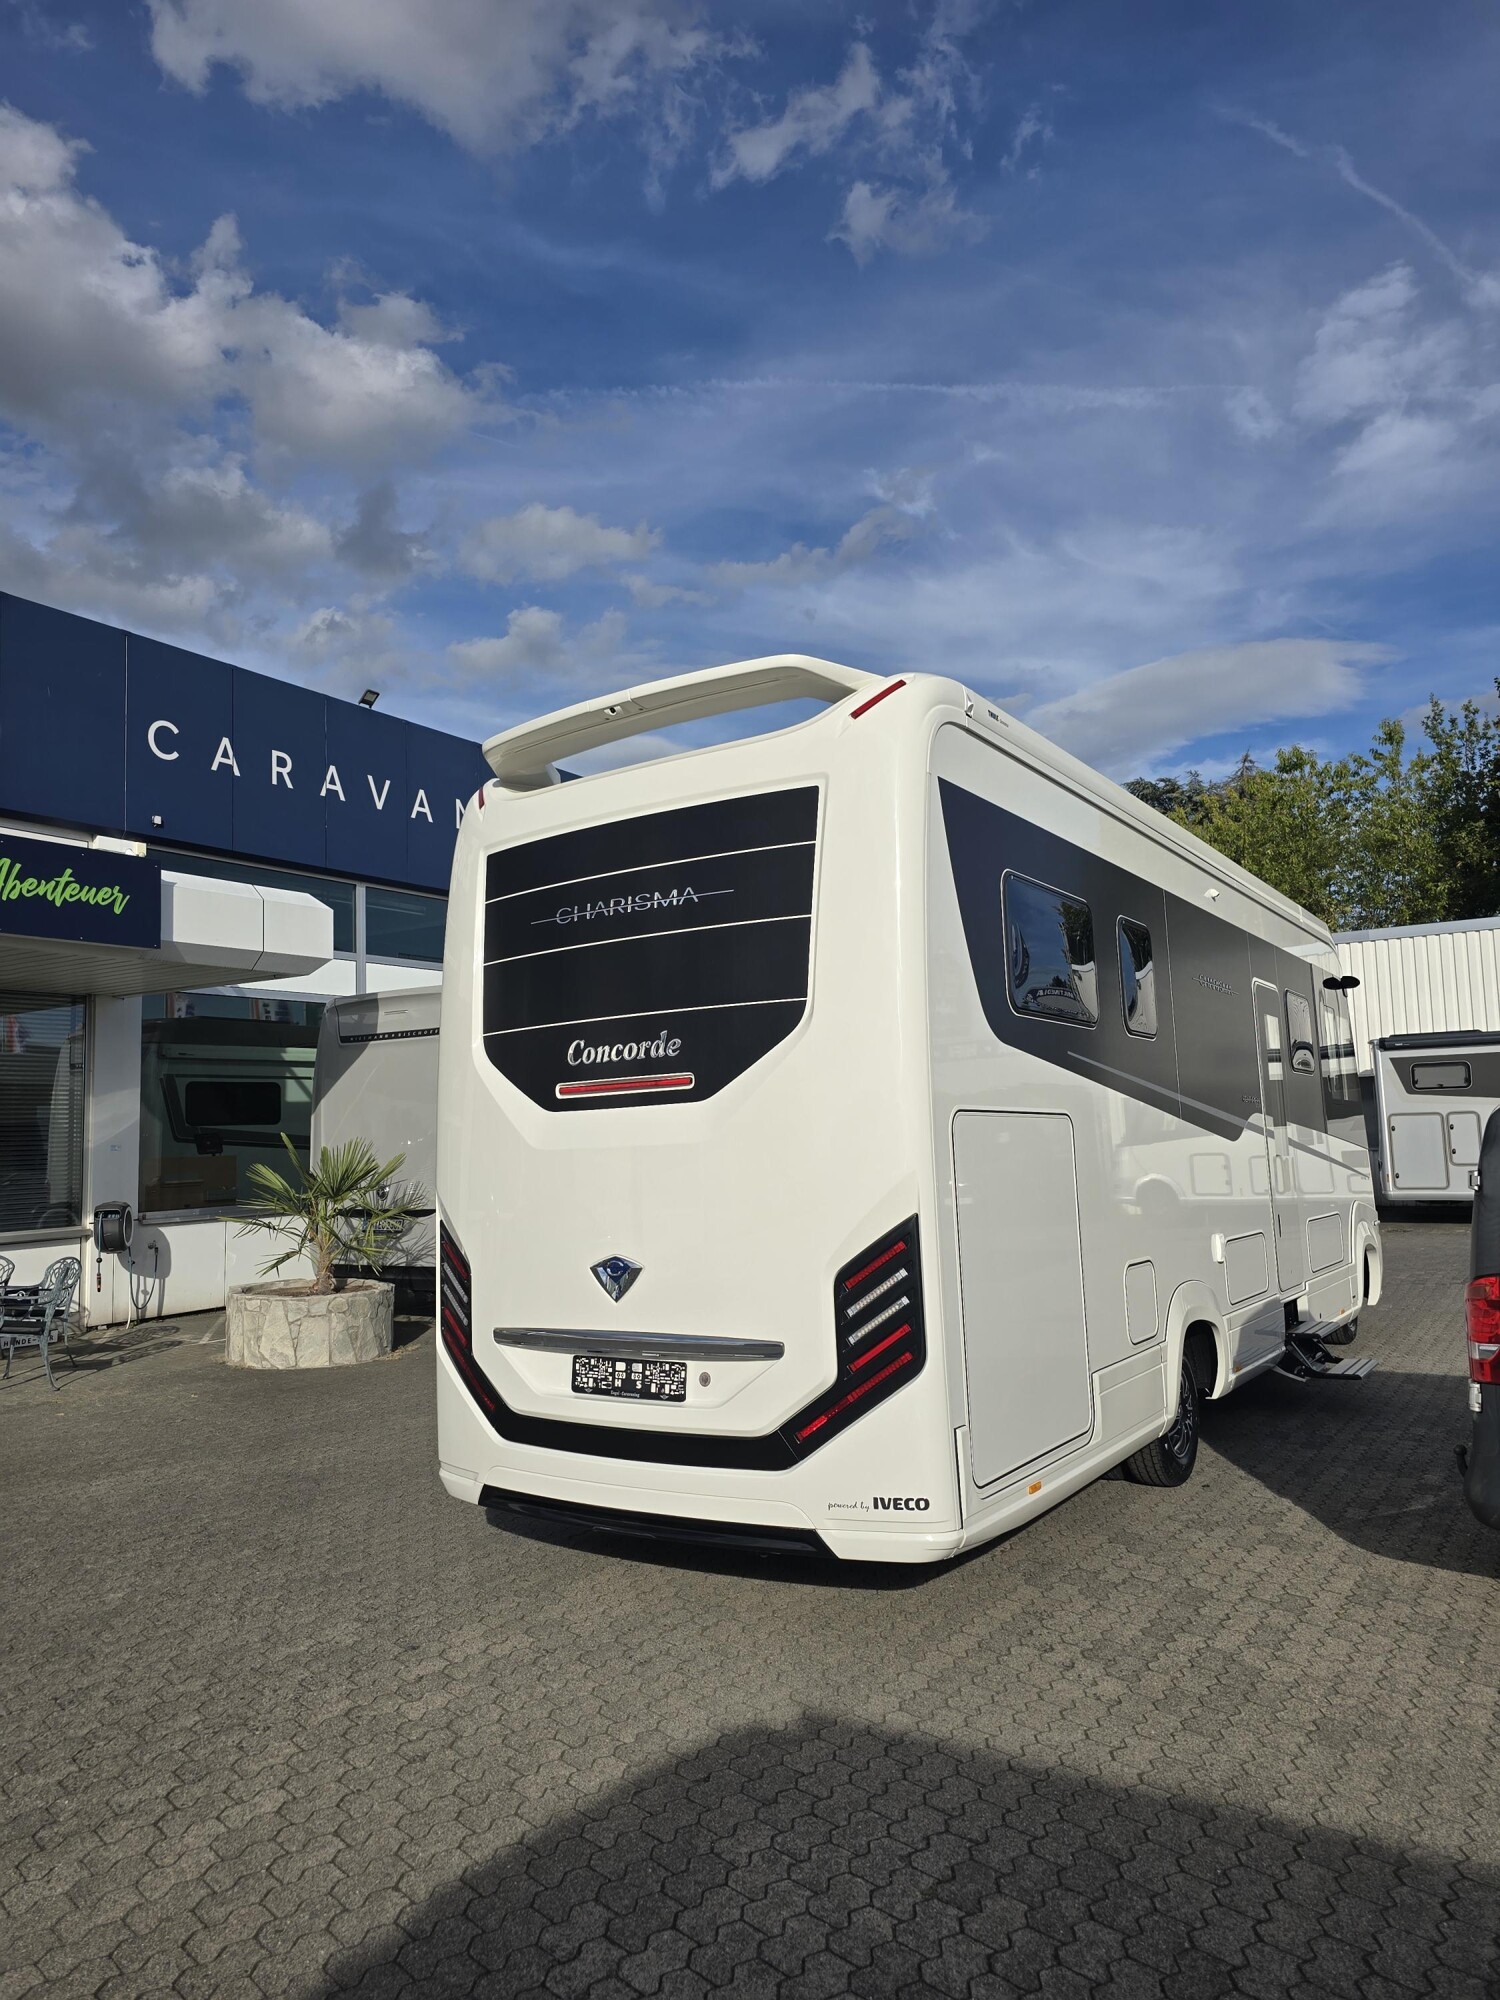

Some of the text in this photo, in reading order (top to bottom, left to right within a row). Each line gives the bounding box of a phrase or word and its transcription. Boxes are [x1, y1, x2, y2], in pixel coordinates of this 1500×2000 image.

[556, 886, 699, 925] CHARISMA
[567, 1029, 682, 1066] Concorde
[3, 1334, 54, 1347] HNDE-R
[827, 1496, 930, 1512] powered by IVECO
